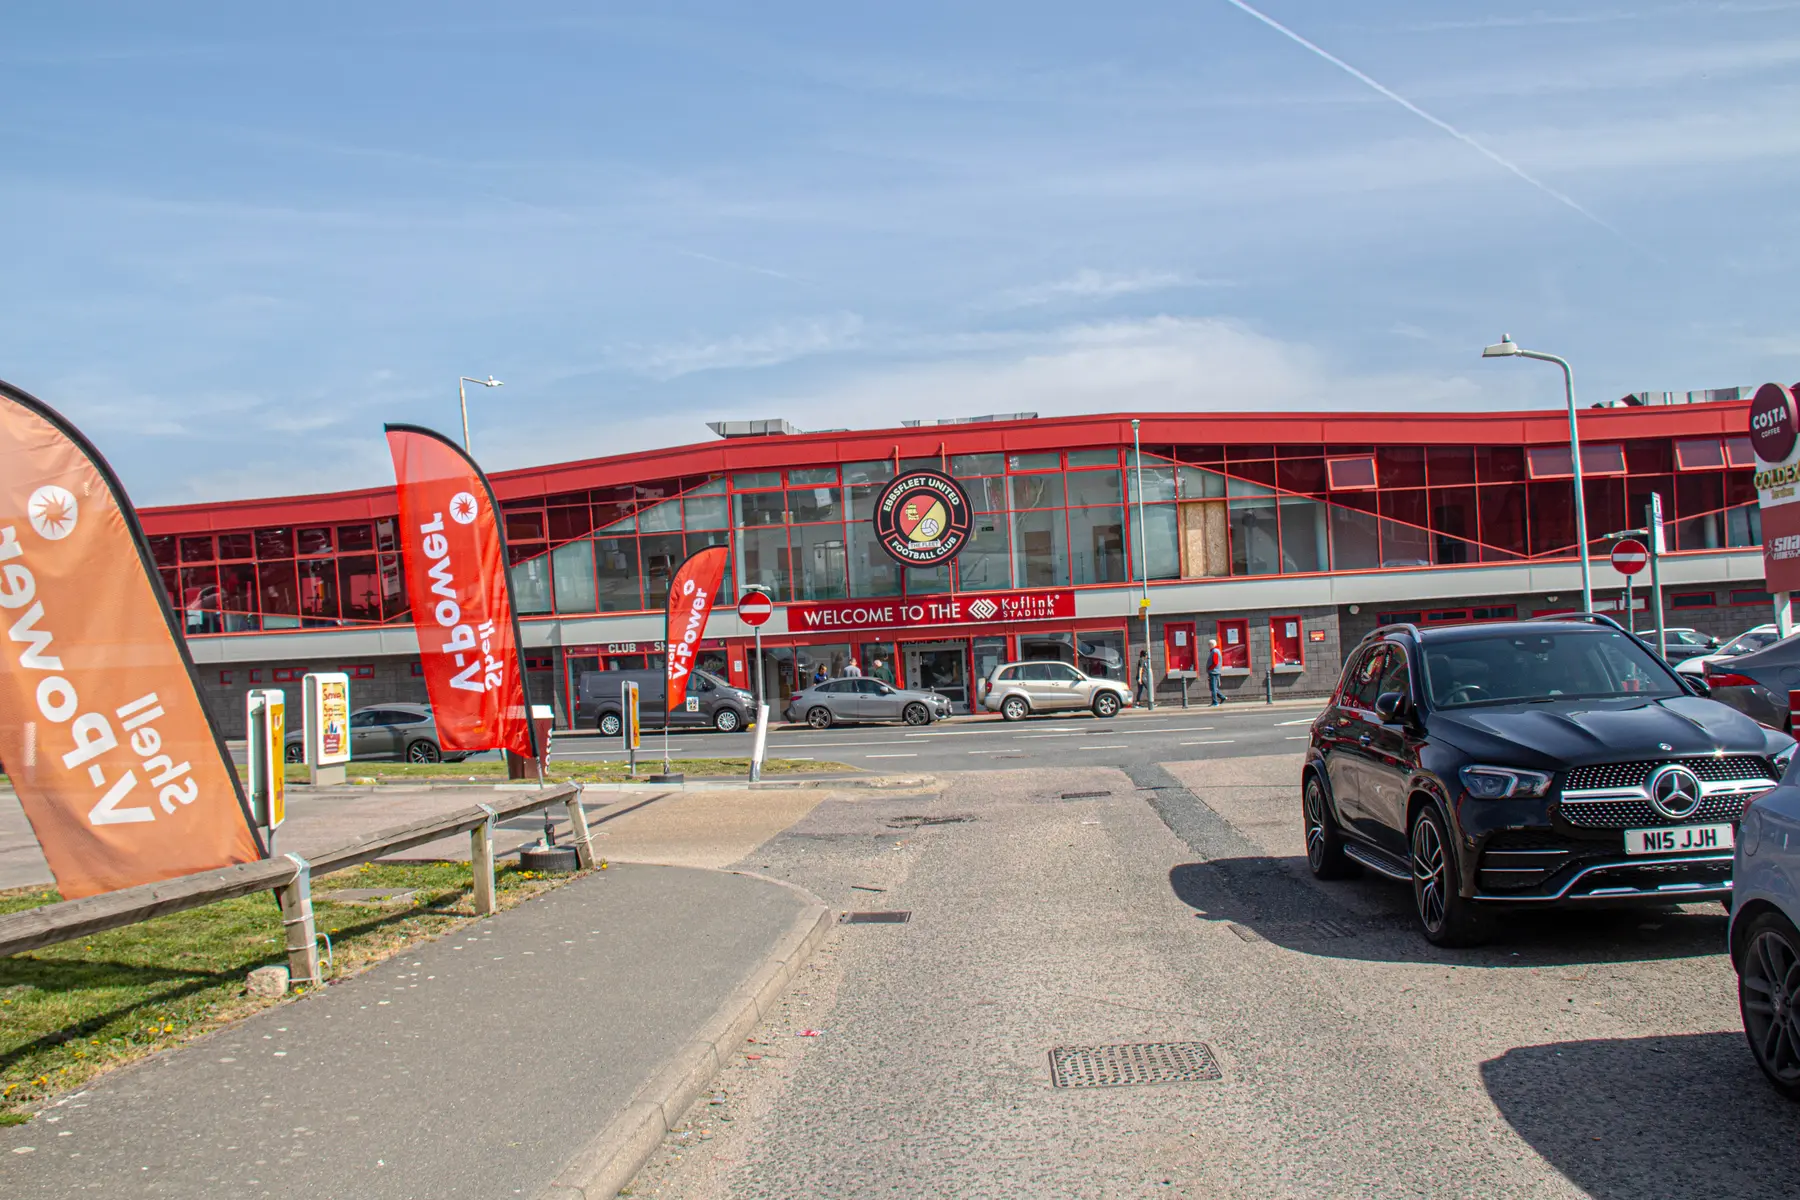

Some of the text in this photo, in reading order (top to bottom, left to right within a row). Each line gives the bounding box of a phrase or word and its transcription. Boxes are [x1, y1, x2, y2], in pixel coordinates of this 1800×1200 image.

[1752, 406, 1787, 430] COSTA
[1761, 426, 1780, 438] COFFEE
[883, 477, 960, 512] EBBSFLEET UNITED
[891, 536, 957, 560] FOOTBALL CLUB
[922, 540, 940, 548] FLEET
[803, 603, 961, 626] WELCOME TO THE
[1002, 608, 1055, 618] STADIUM
[672, 587, 708, 680] V-Power
[608, 643, 637, 654] CLUB
[1643, 828, 1718, 851] N15 JJH
